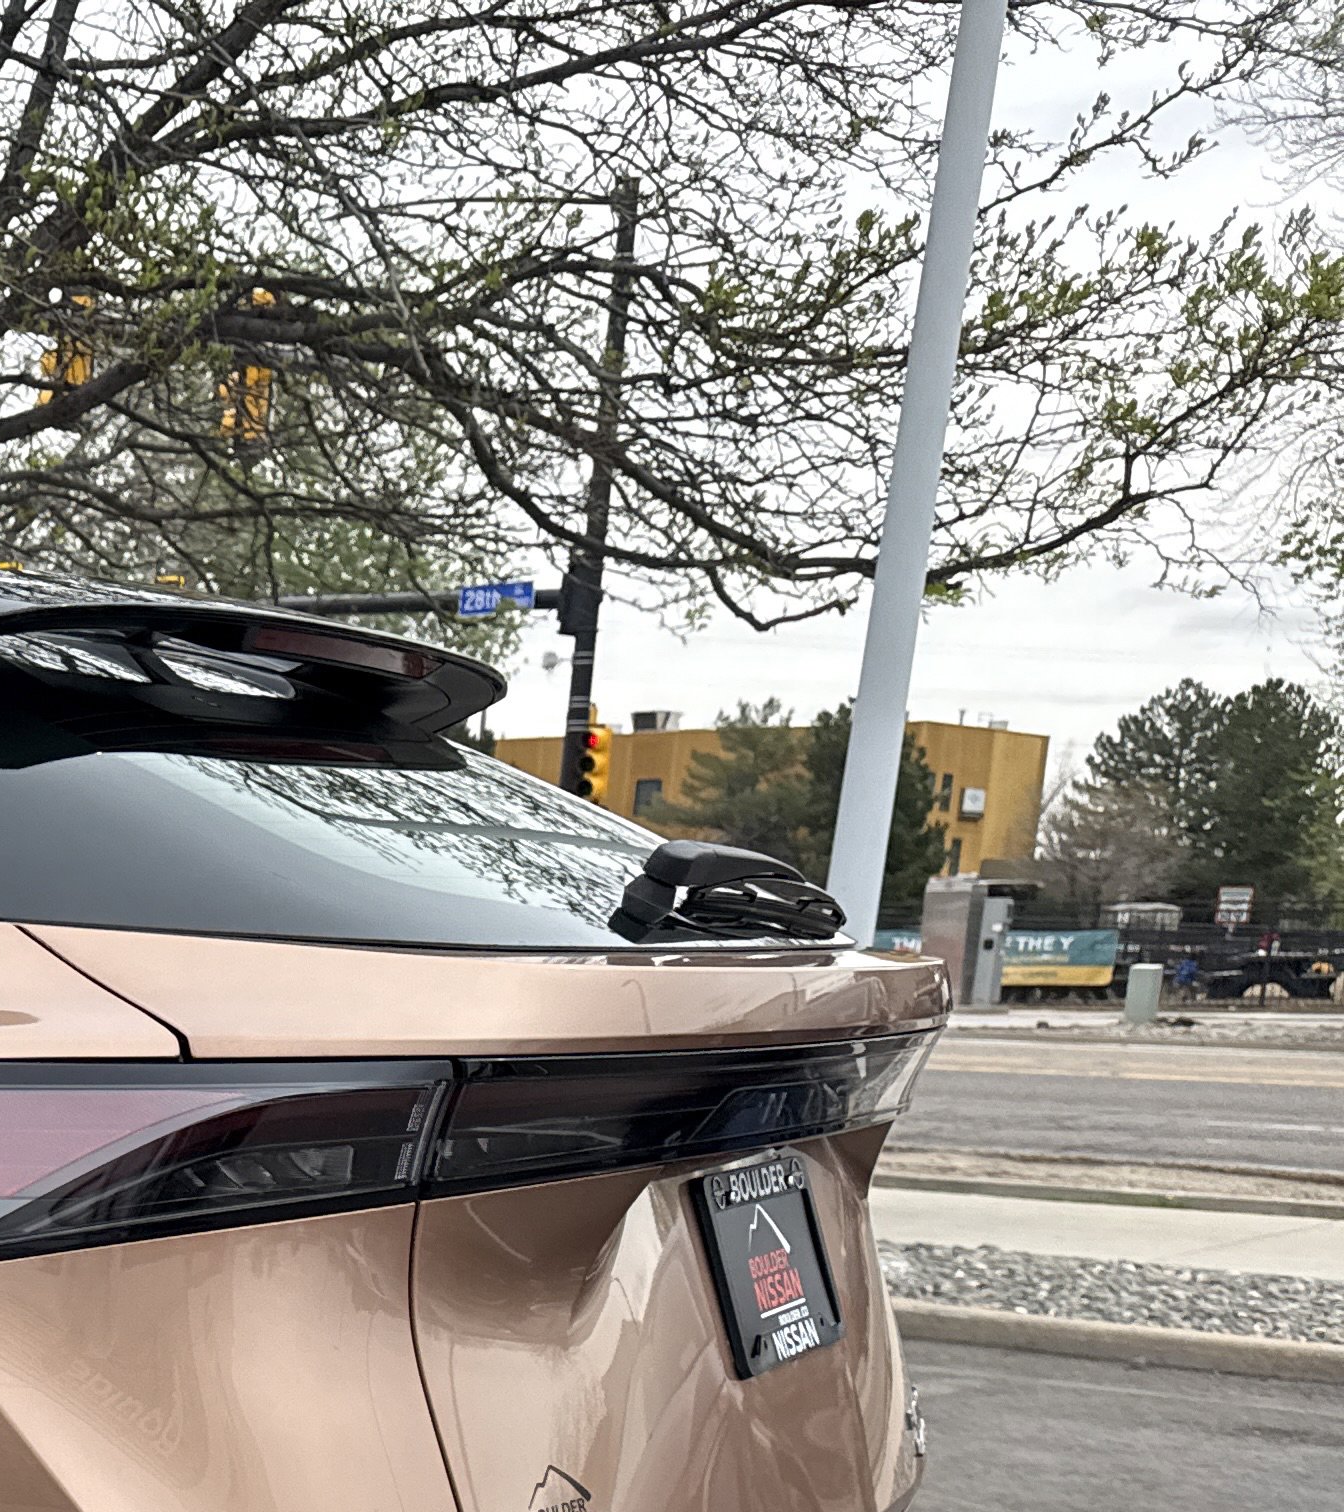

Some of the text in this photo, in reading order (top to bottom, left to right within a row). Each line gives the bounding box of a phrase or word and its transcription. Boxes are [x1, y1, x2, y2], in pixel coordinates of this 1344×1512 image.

[730, 1164, 788, 1201] BOULDER
[748, 1249, 790, 1278] BOULDER
[754, 1267, 804, 1311] NISSAN
[772, 1317, 820, 1361] NISSAN
